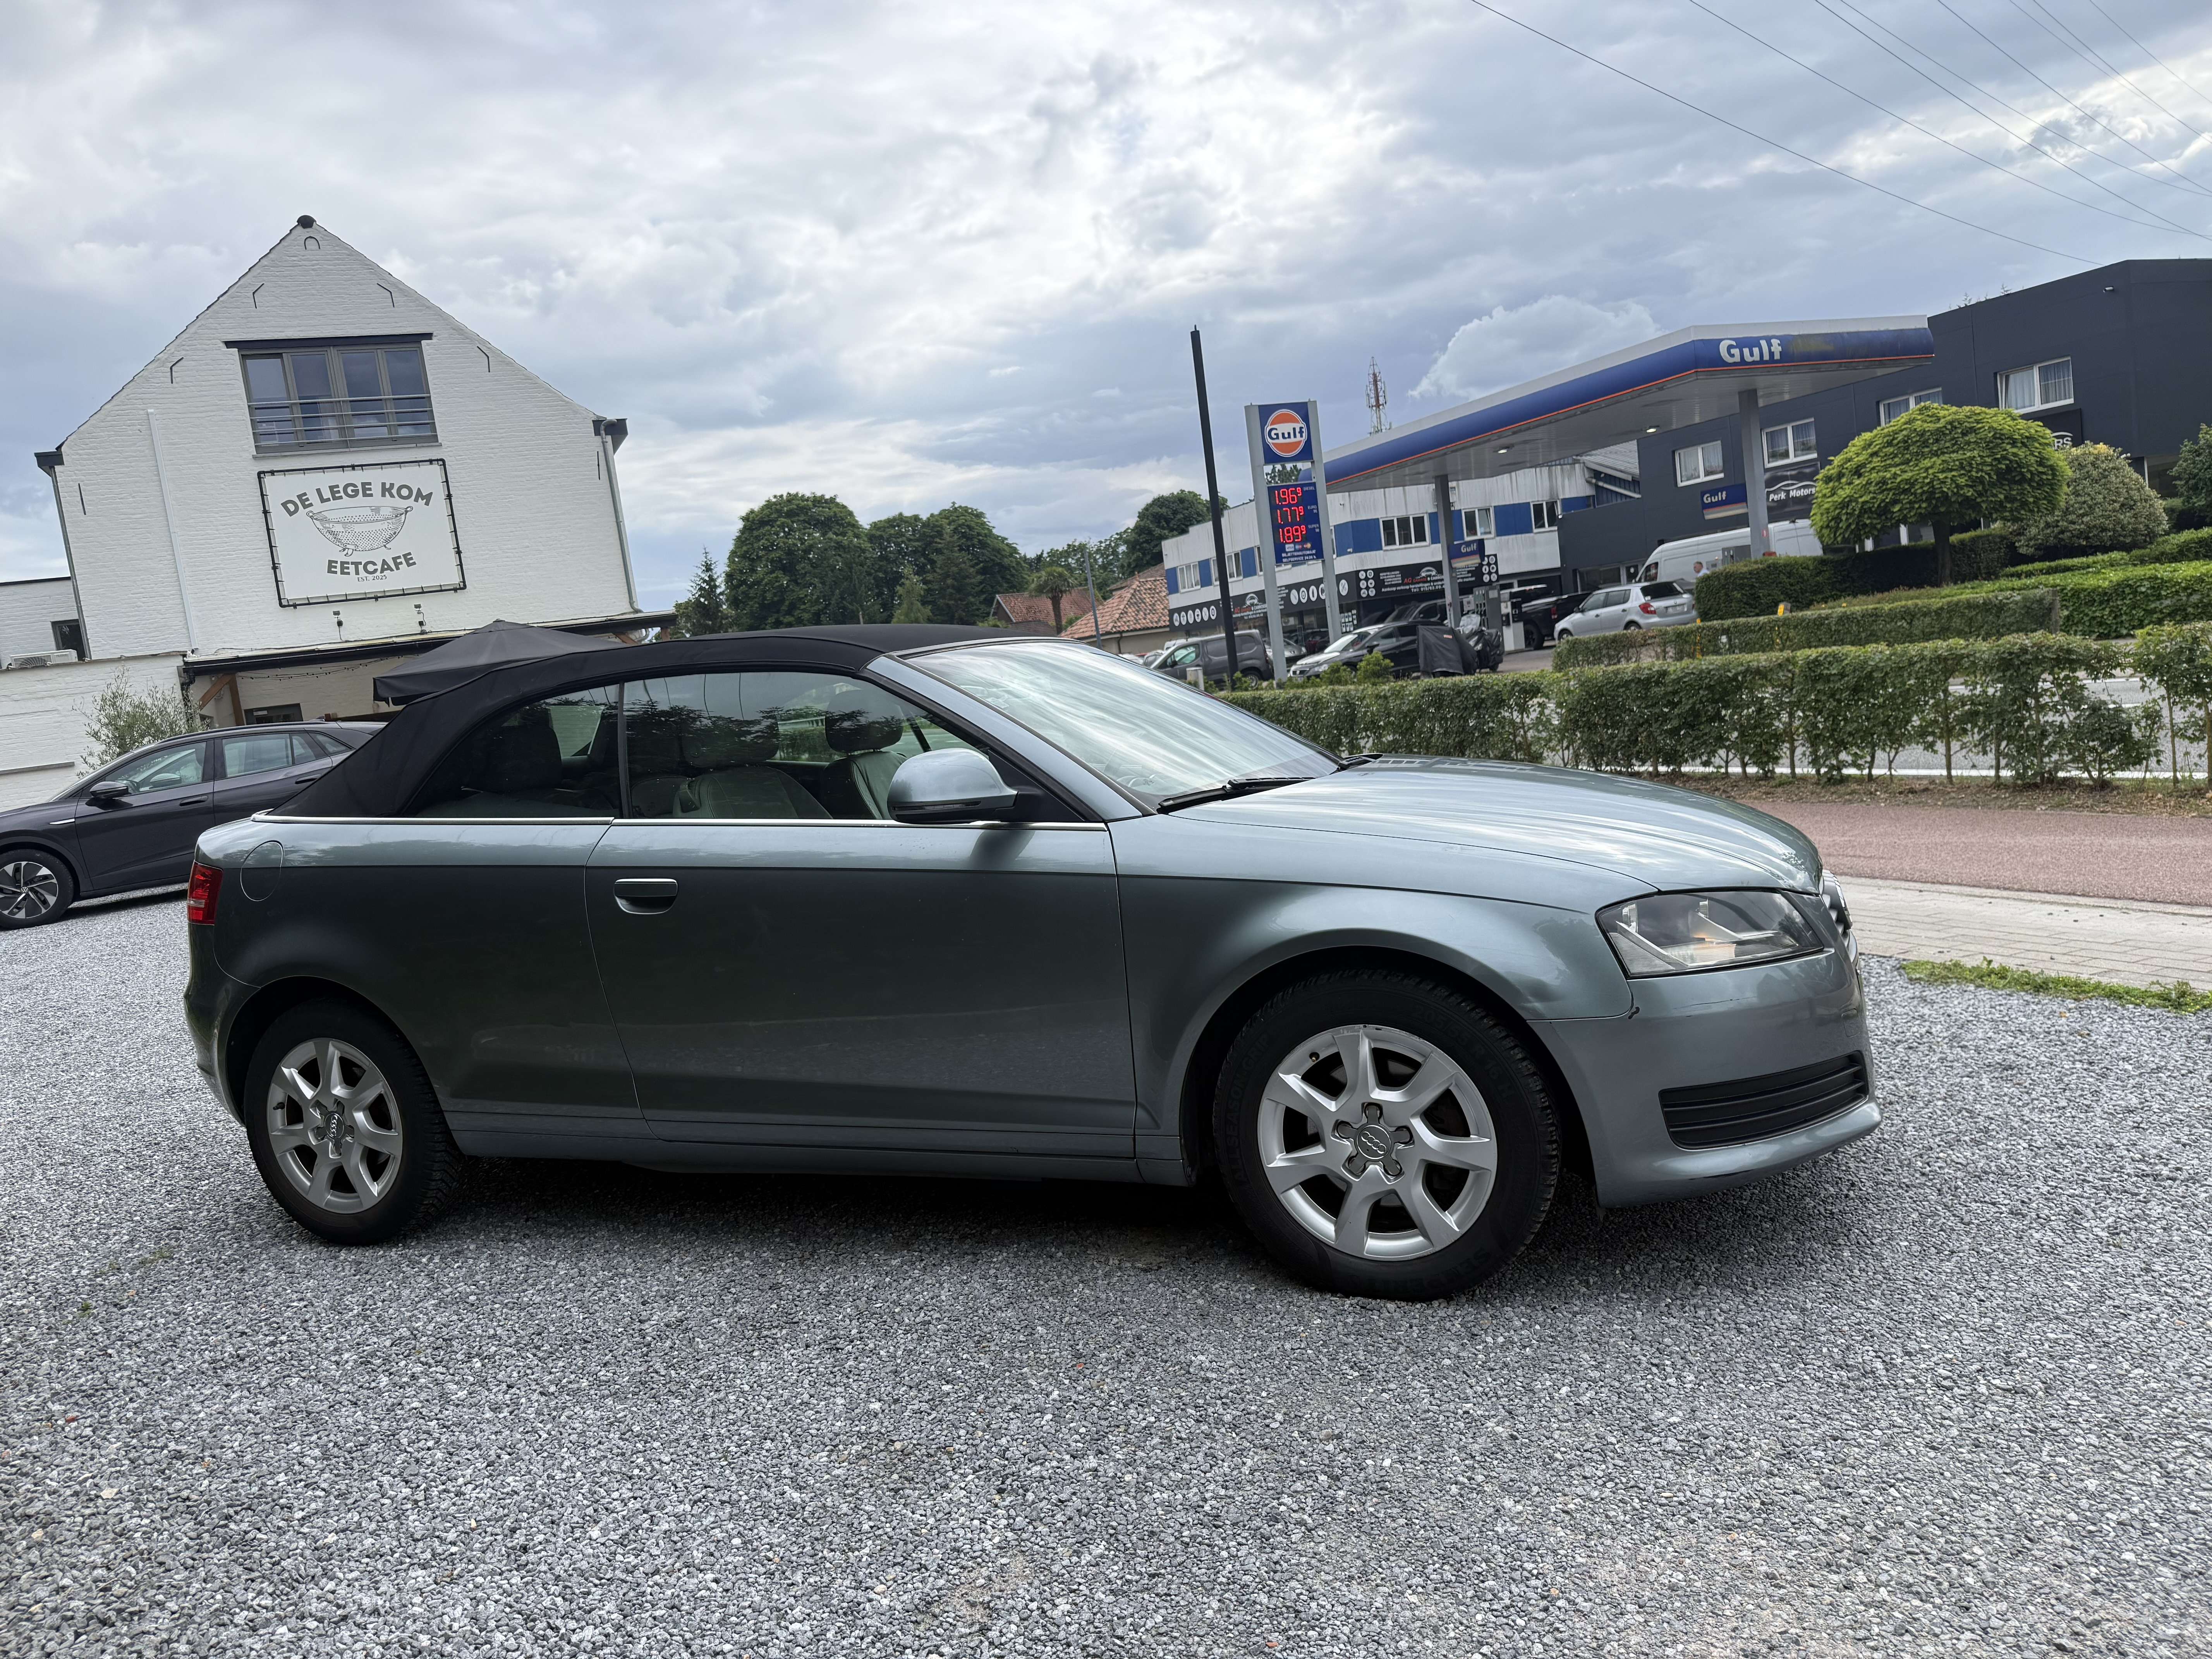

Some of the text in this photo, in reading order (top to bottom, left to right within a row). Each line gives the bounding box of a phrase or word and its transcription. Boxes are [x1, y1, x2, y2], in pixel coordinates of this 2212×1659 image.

[1719, 338, 1781, 363] Gulf
[1267, 426, 1304, 441] Gulf
[281, 482, 433, 517] DE LEGE KOM
[1703, 491, 1726, 503] Gulf
[1769, 487, 1816, 502] Perk Motors
[1461, 543, 1477, 553] Gulf
[327, 552, 417, 576] EETCAFE
